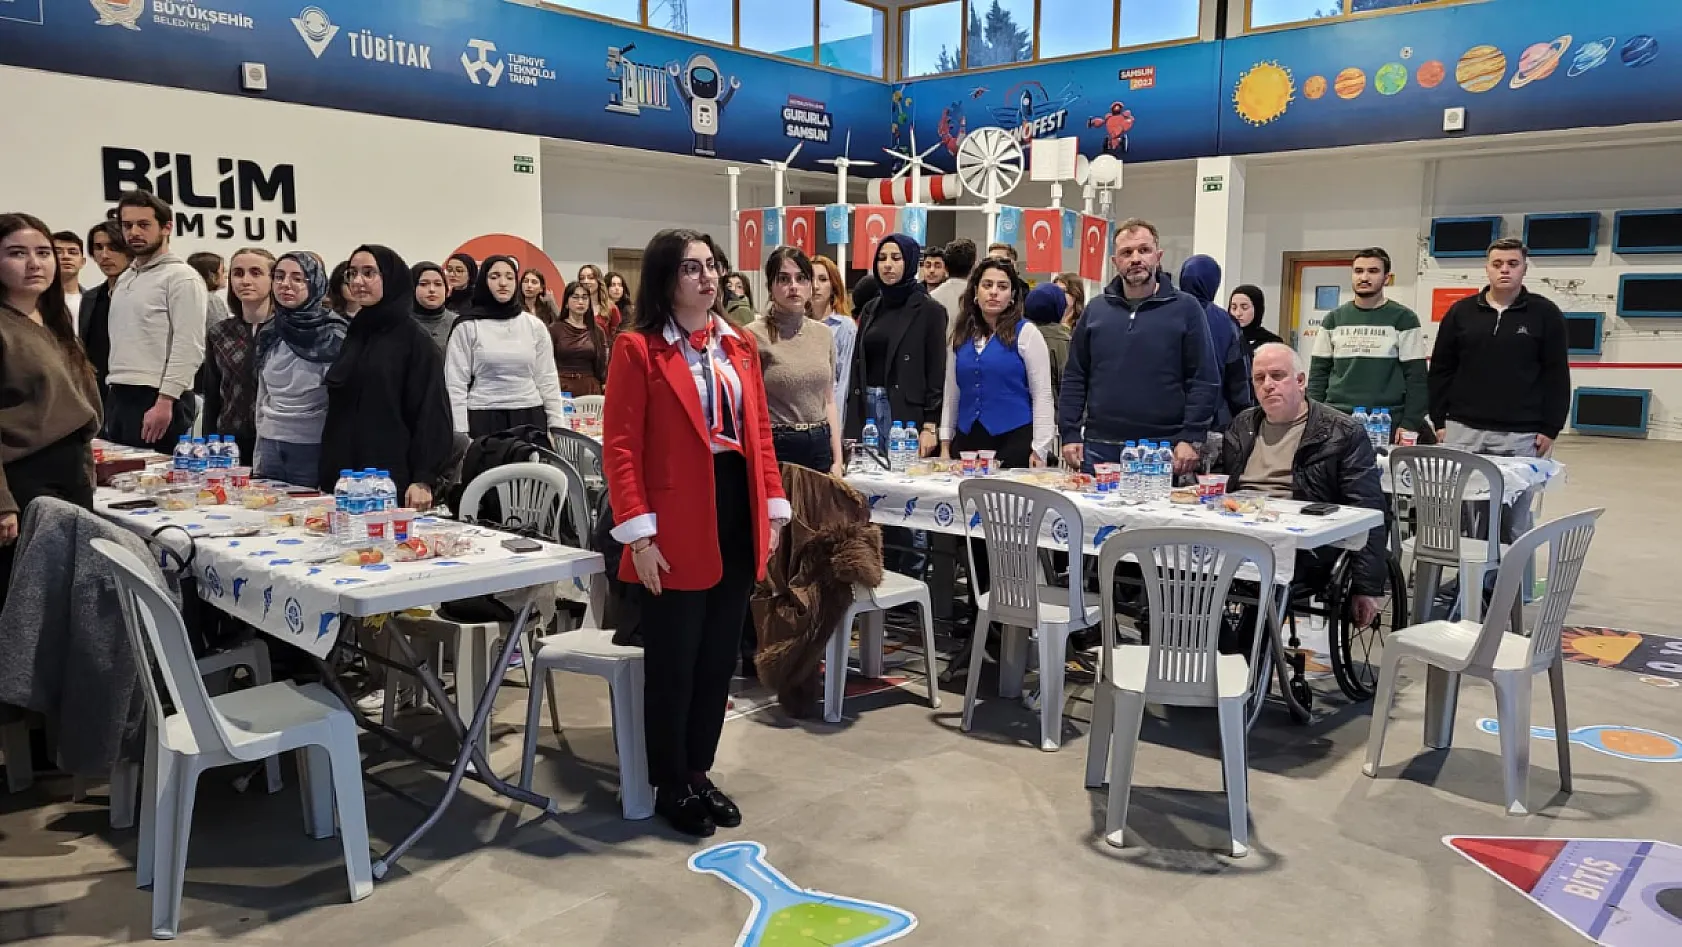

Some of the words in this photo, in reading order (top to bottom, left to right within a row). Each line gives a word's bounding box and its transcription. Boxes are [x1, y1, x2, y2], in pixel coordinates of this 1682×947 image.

[153, 0, 254, 29] BÜYÜKŞEHİR
[153, 15, 210, 31] BELEDİYESİ
[348, 29, 432, 70] TÜBİTAK
[1120, 67, 1154, 80] SAMSUN
[783, 107, 830, 127] GURURLA
[1010, 109, 1066, 142] NOFEST
[786, 123, 828, 142] SAMSUN
[107, 208, 297, 243] MSUN
[1558, 856, 1623, 901] BİTİŞ
